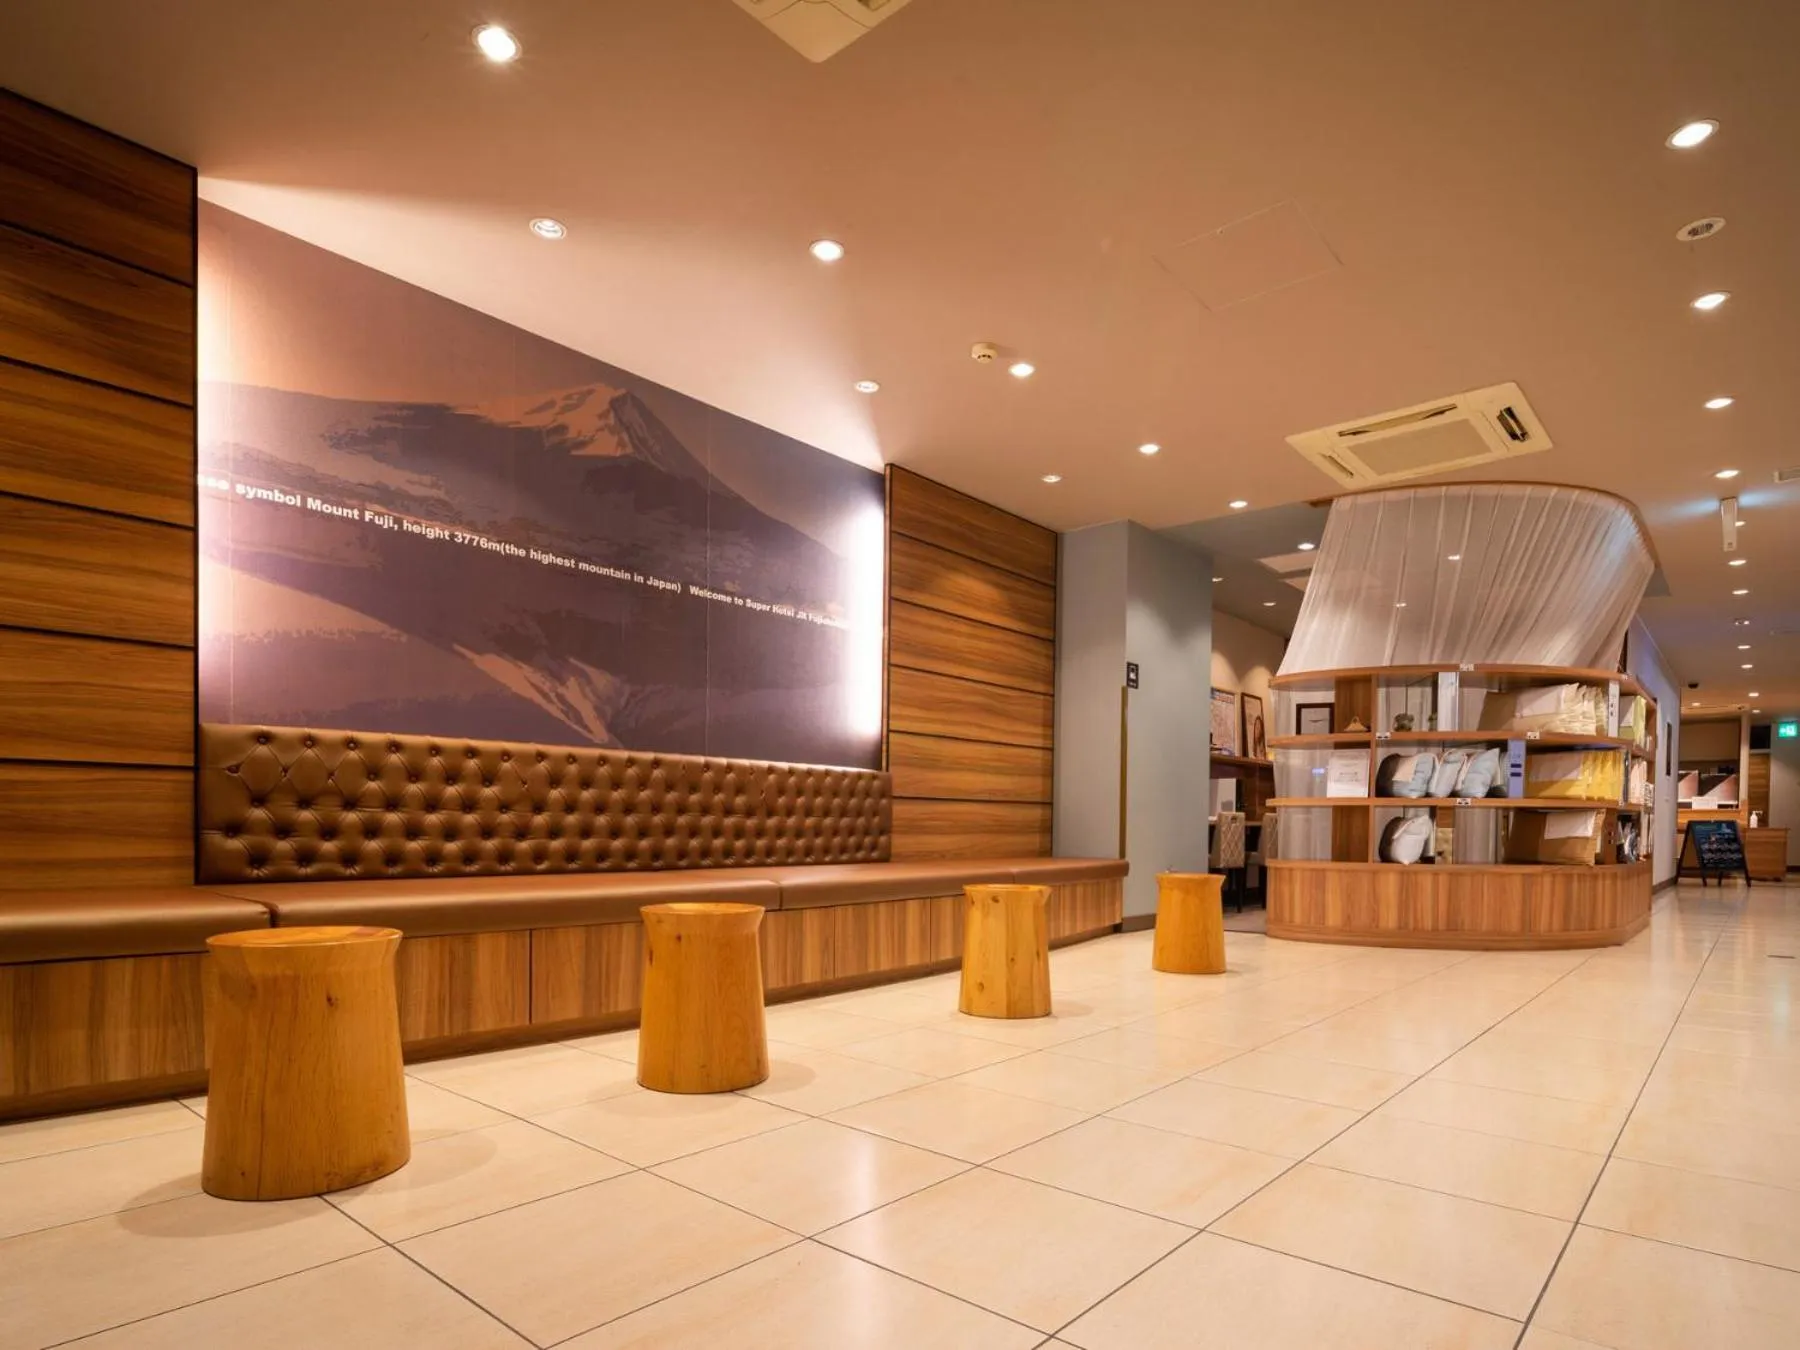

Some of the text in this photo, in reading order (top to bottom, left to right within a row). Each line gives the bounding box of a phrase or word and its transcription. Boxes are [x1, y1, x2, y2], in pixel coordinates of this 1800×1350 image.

[235, 483, 301, 507] symbol
[306, 497, 360, 520] Mount
[364, 510, 398, 531] Fuji,
[402, 520, 450, 540] height
[454, 531, 526, 557] 3776m(the
[529, 548, 576, 568] highest
[578, 561, 631, 581] mountain
[633, 572, 644, 584] in
[646, 576, 682, 593] Japan)
[689, 585, 733, 604] Welcome
[733, 597, 744, 606] to
[745, 599, 771, 612] Super
